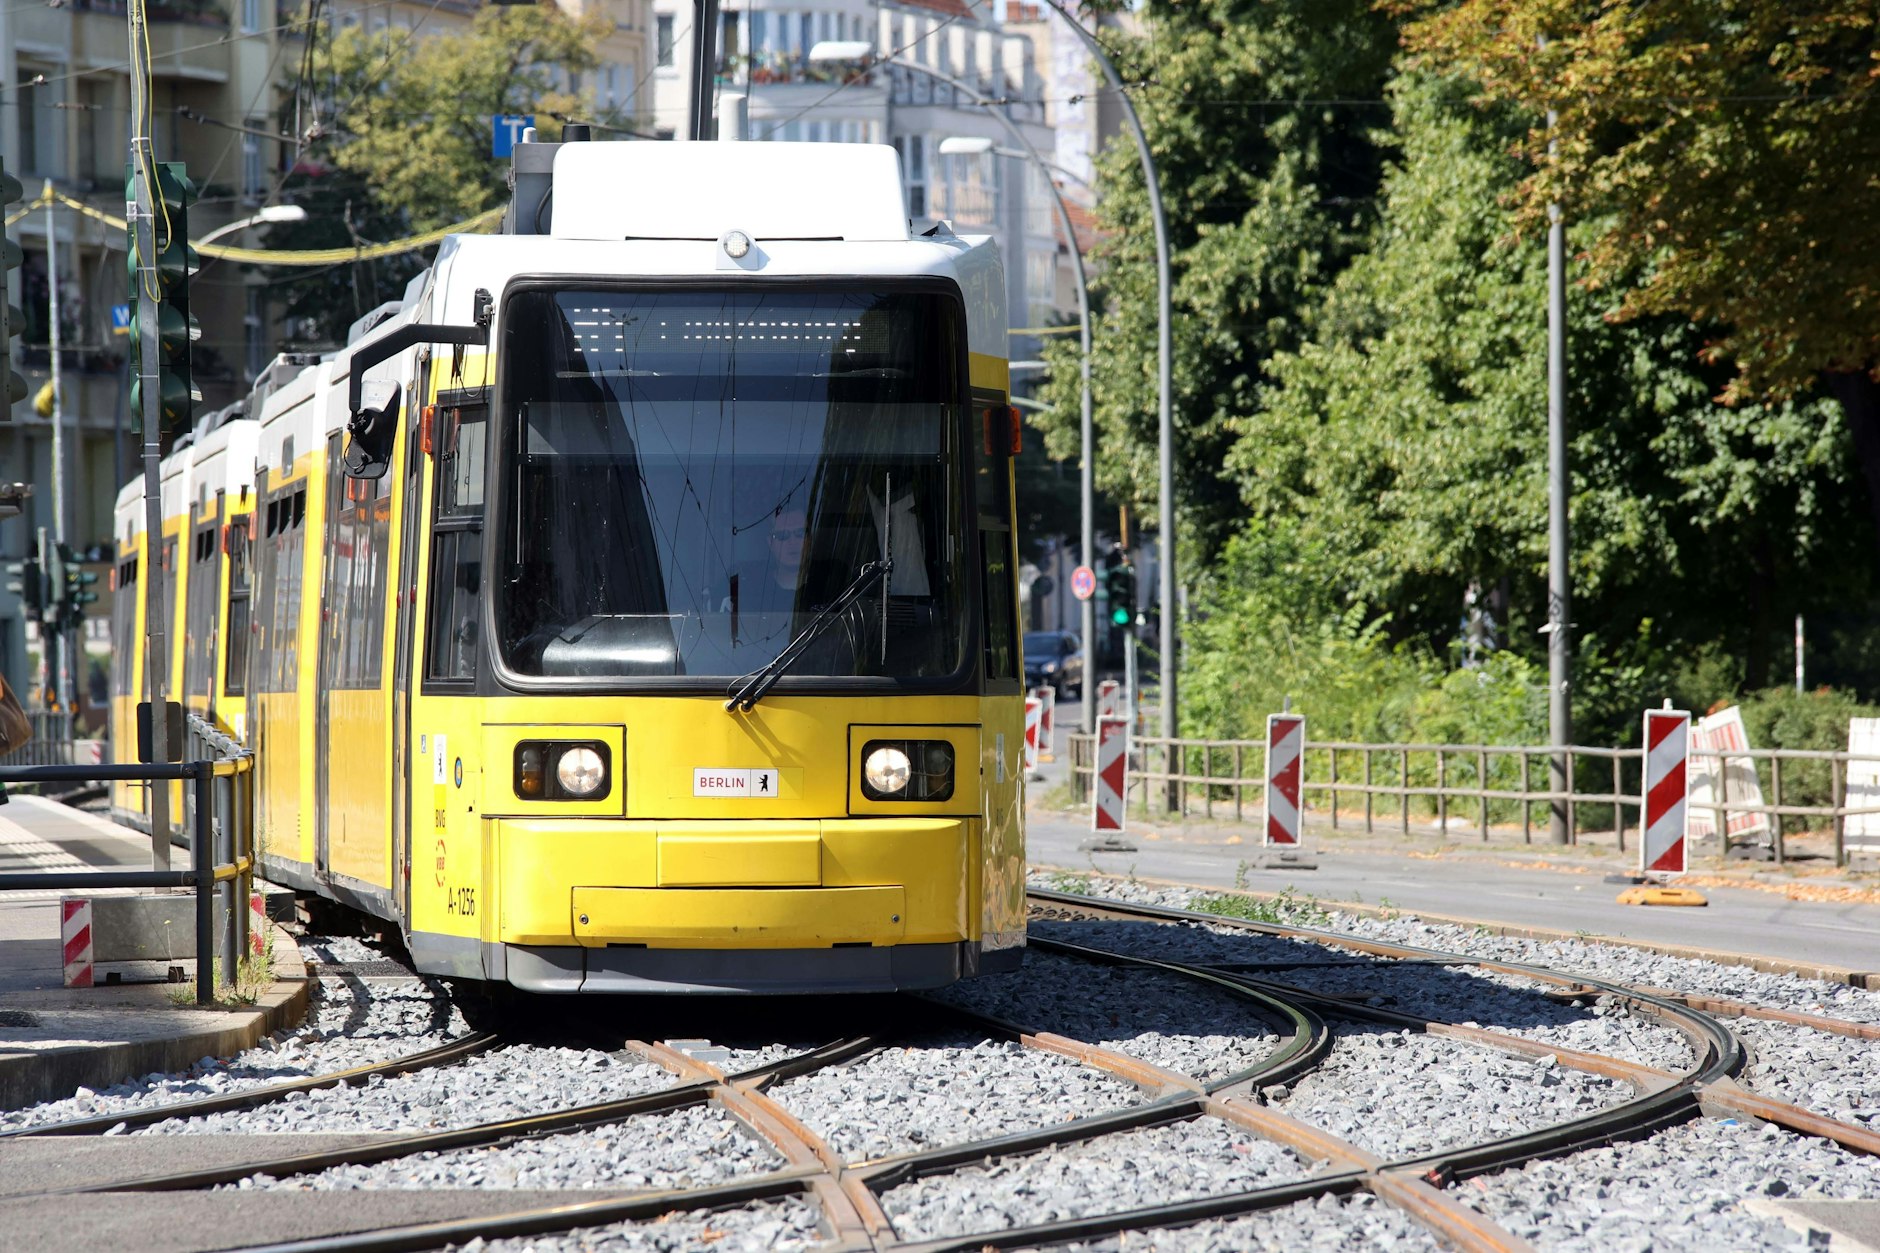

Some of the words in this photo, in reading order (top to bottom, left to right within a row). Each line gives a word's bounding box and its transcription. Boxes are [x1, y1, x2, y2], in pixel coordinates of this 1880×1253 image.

[700, 777, 744, 788] BERLIN
[436, 809, 446, 828] BVG
[448, 887, 476, 917] A-1256
